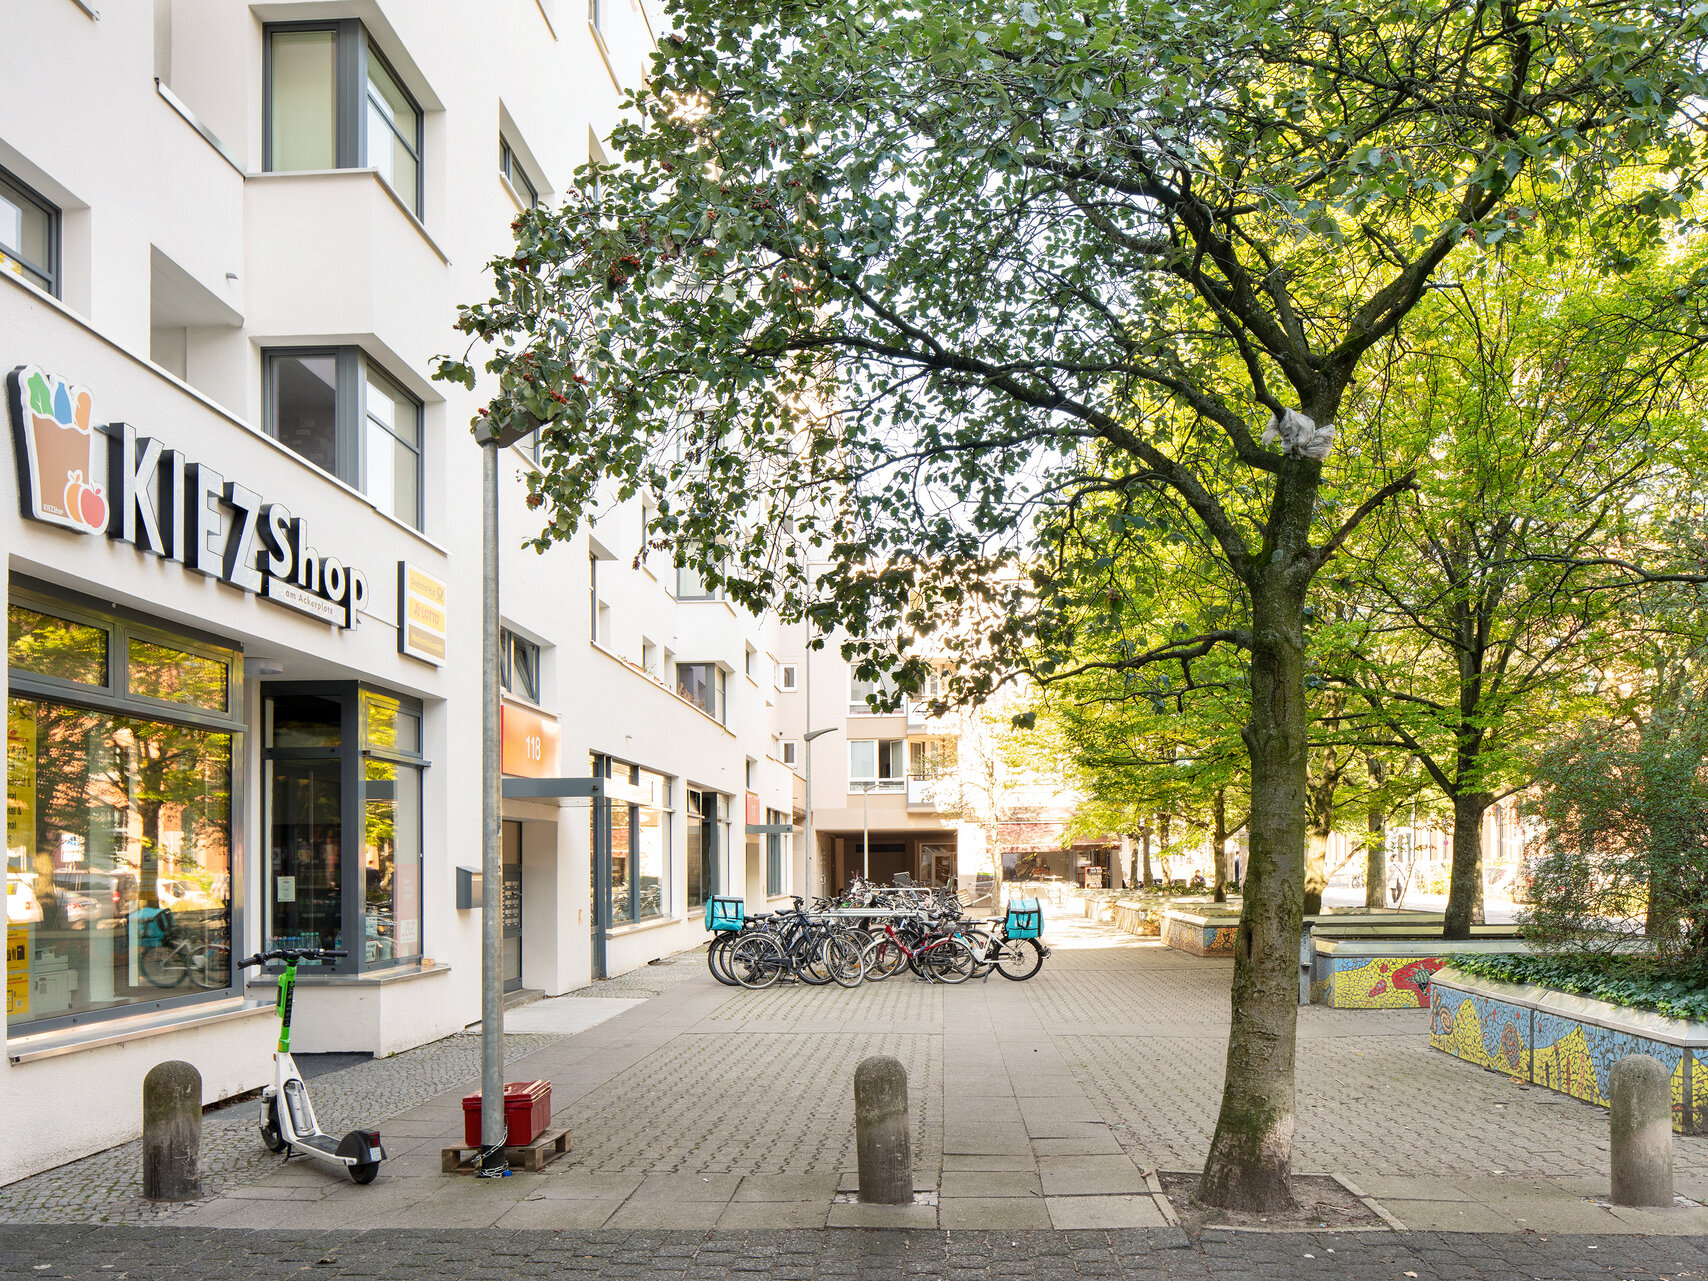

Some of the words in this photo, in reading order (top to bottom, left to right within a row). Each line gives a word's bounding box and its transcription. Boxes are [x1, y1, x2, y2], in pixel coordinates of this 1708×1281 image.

[286, 590, 297, 600] am
[298, 594, 333, 615] Ackerplatz
[422, 605, 440, 626] LOTTO
[526, 735, 541, 761] 118
